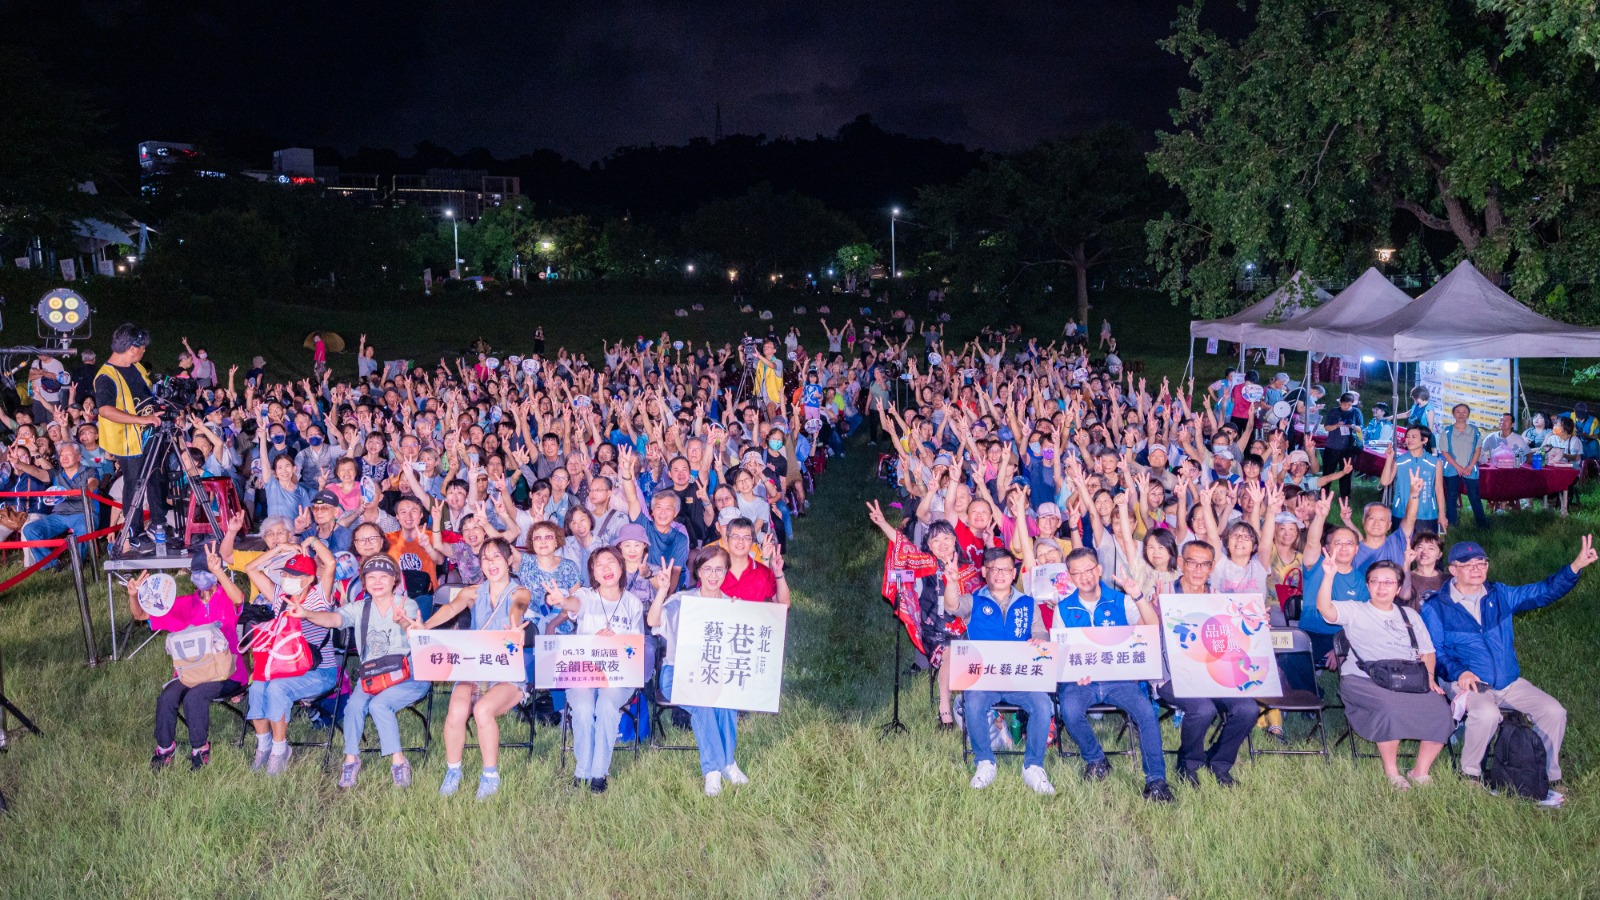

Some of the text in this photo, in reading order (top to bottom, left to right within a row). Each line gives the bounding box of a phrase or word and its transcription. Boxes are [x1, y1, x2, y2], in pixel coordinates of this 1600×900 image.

[1205, 624, 1234, 638] 品味
[757, 625, 773, 653] 新北
[1212, 639, 1241, 653] 經典
[430, 652, 510, 666] 好歌一起唱
[562, 648, 618, 658] 09.13 新店區
[700, 621, 724, 685] 藝起來
[724, 623, 755, 688] 巷弄
[1069, 651, 1147, 666] 精彩零距離
[555, 660, 620, 673] 金韻民歌夜
[968, 662, 1044, 676] 新北藝起來
